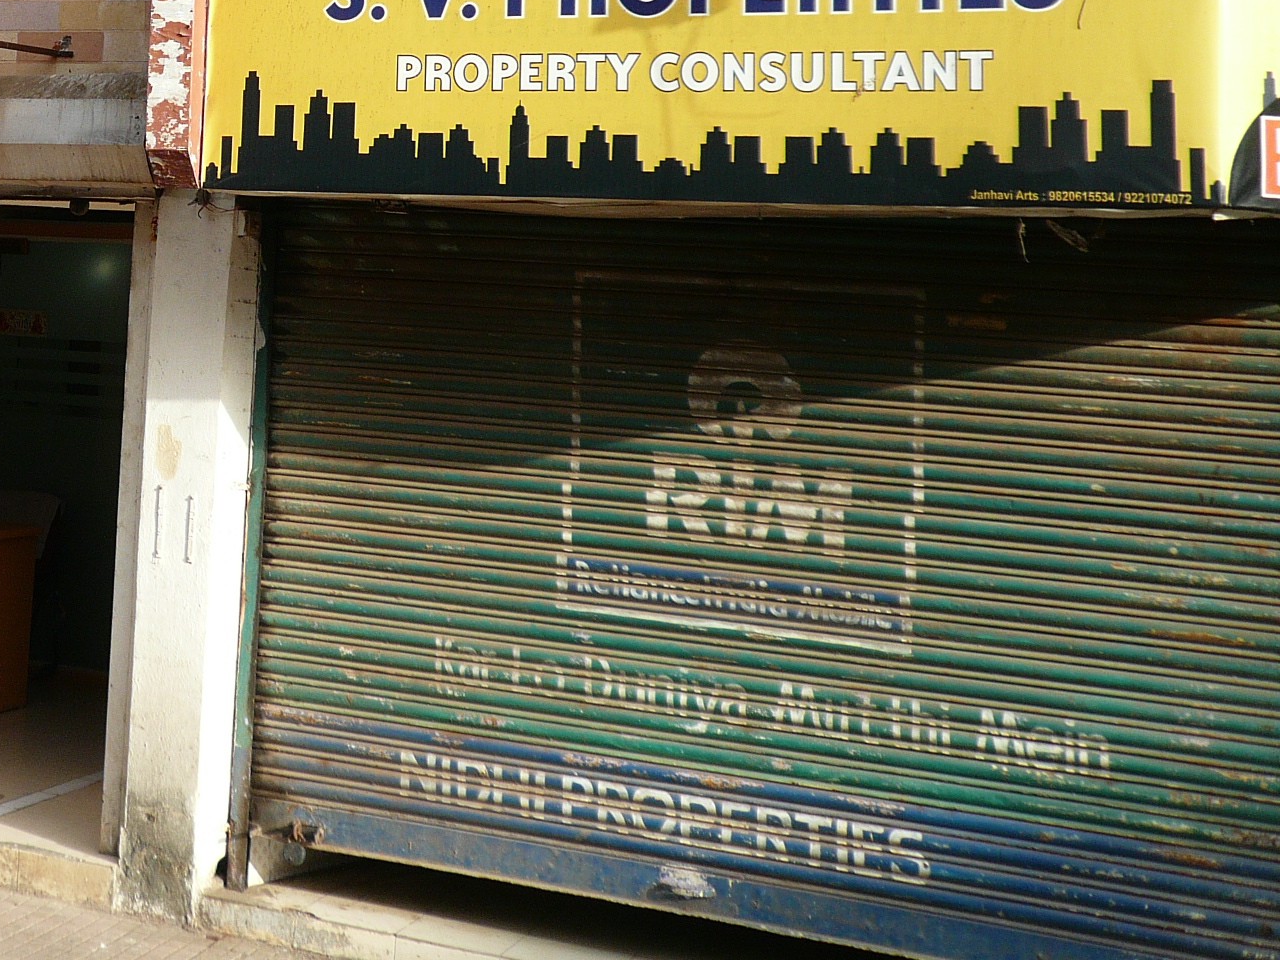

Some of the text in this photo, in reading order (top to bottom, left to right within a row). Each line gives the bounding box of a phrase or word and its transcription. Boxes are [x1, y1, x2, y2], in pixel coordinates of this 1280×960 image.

[396, 49, 994, 94] PROPERTY CONSULTANT
[971, 190, 1013, 202] Janhavi
[1016, 190, 1039, 201] Arts
[1049, 191, 1115, 203] 9820615534
[1124, 193, 1192, 205] 9221074072
[562, 774, 931, 886] PROPERTIES
